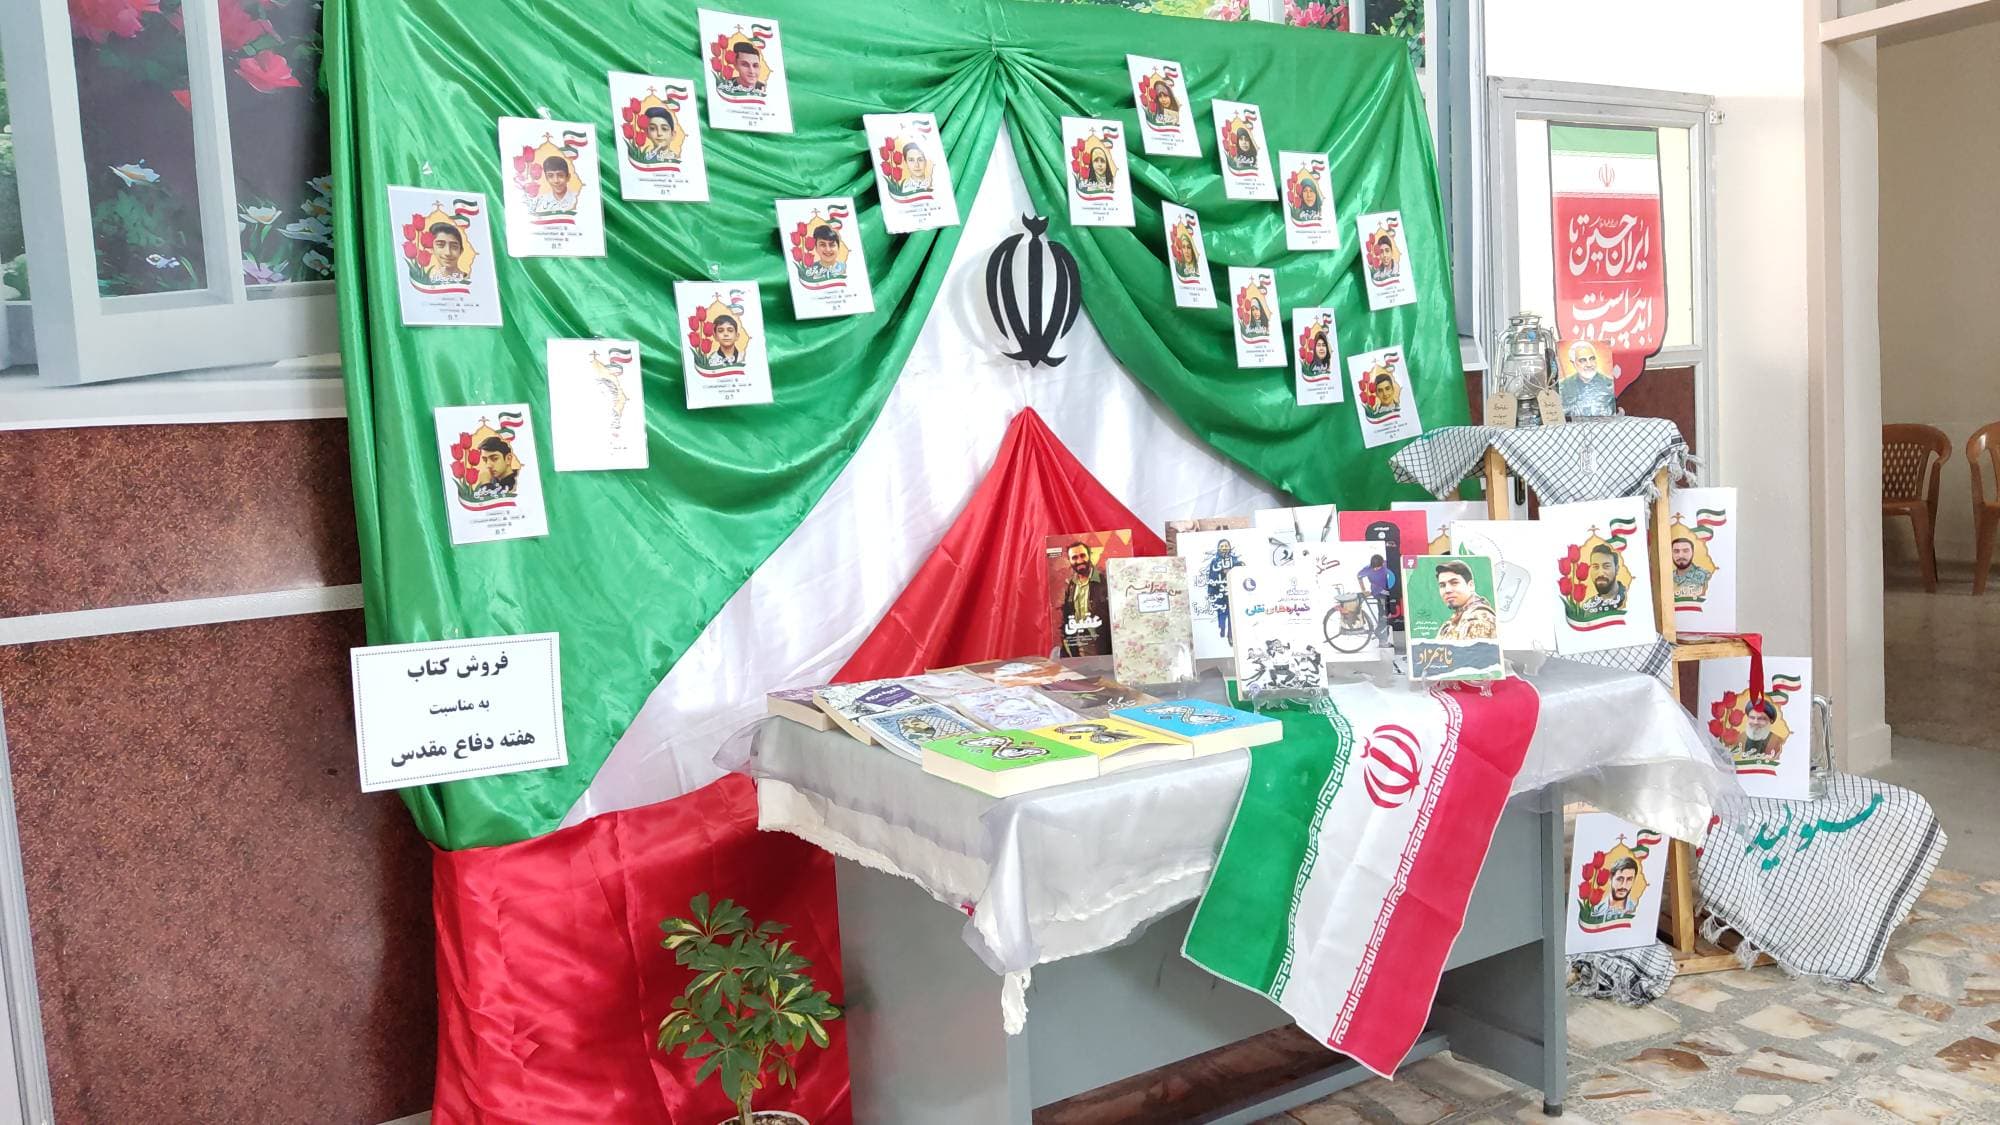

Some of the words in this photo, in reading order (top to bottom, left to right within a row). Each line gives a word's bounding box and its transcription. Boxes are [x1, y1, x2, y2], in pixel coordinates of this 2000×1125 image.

[1064, 611, 1103, 636] عقیق
[407, 657, 450, 682] کتاب
[456, 651, 509, 678] فروش
[429, 699, 475, 717] مناسبت
[478, 699, 490, 712] به
[453, 732, 495, 760] دفاع
[499, 729, 536, 747] هفته
[391, 740, 448, 767] مقدس
